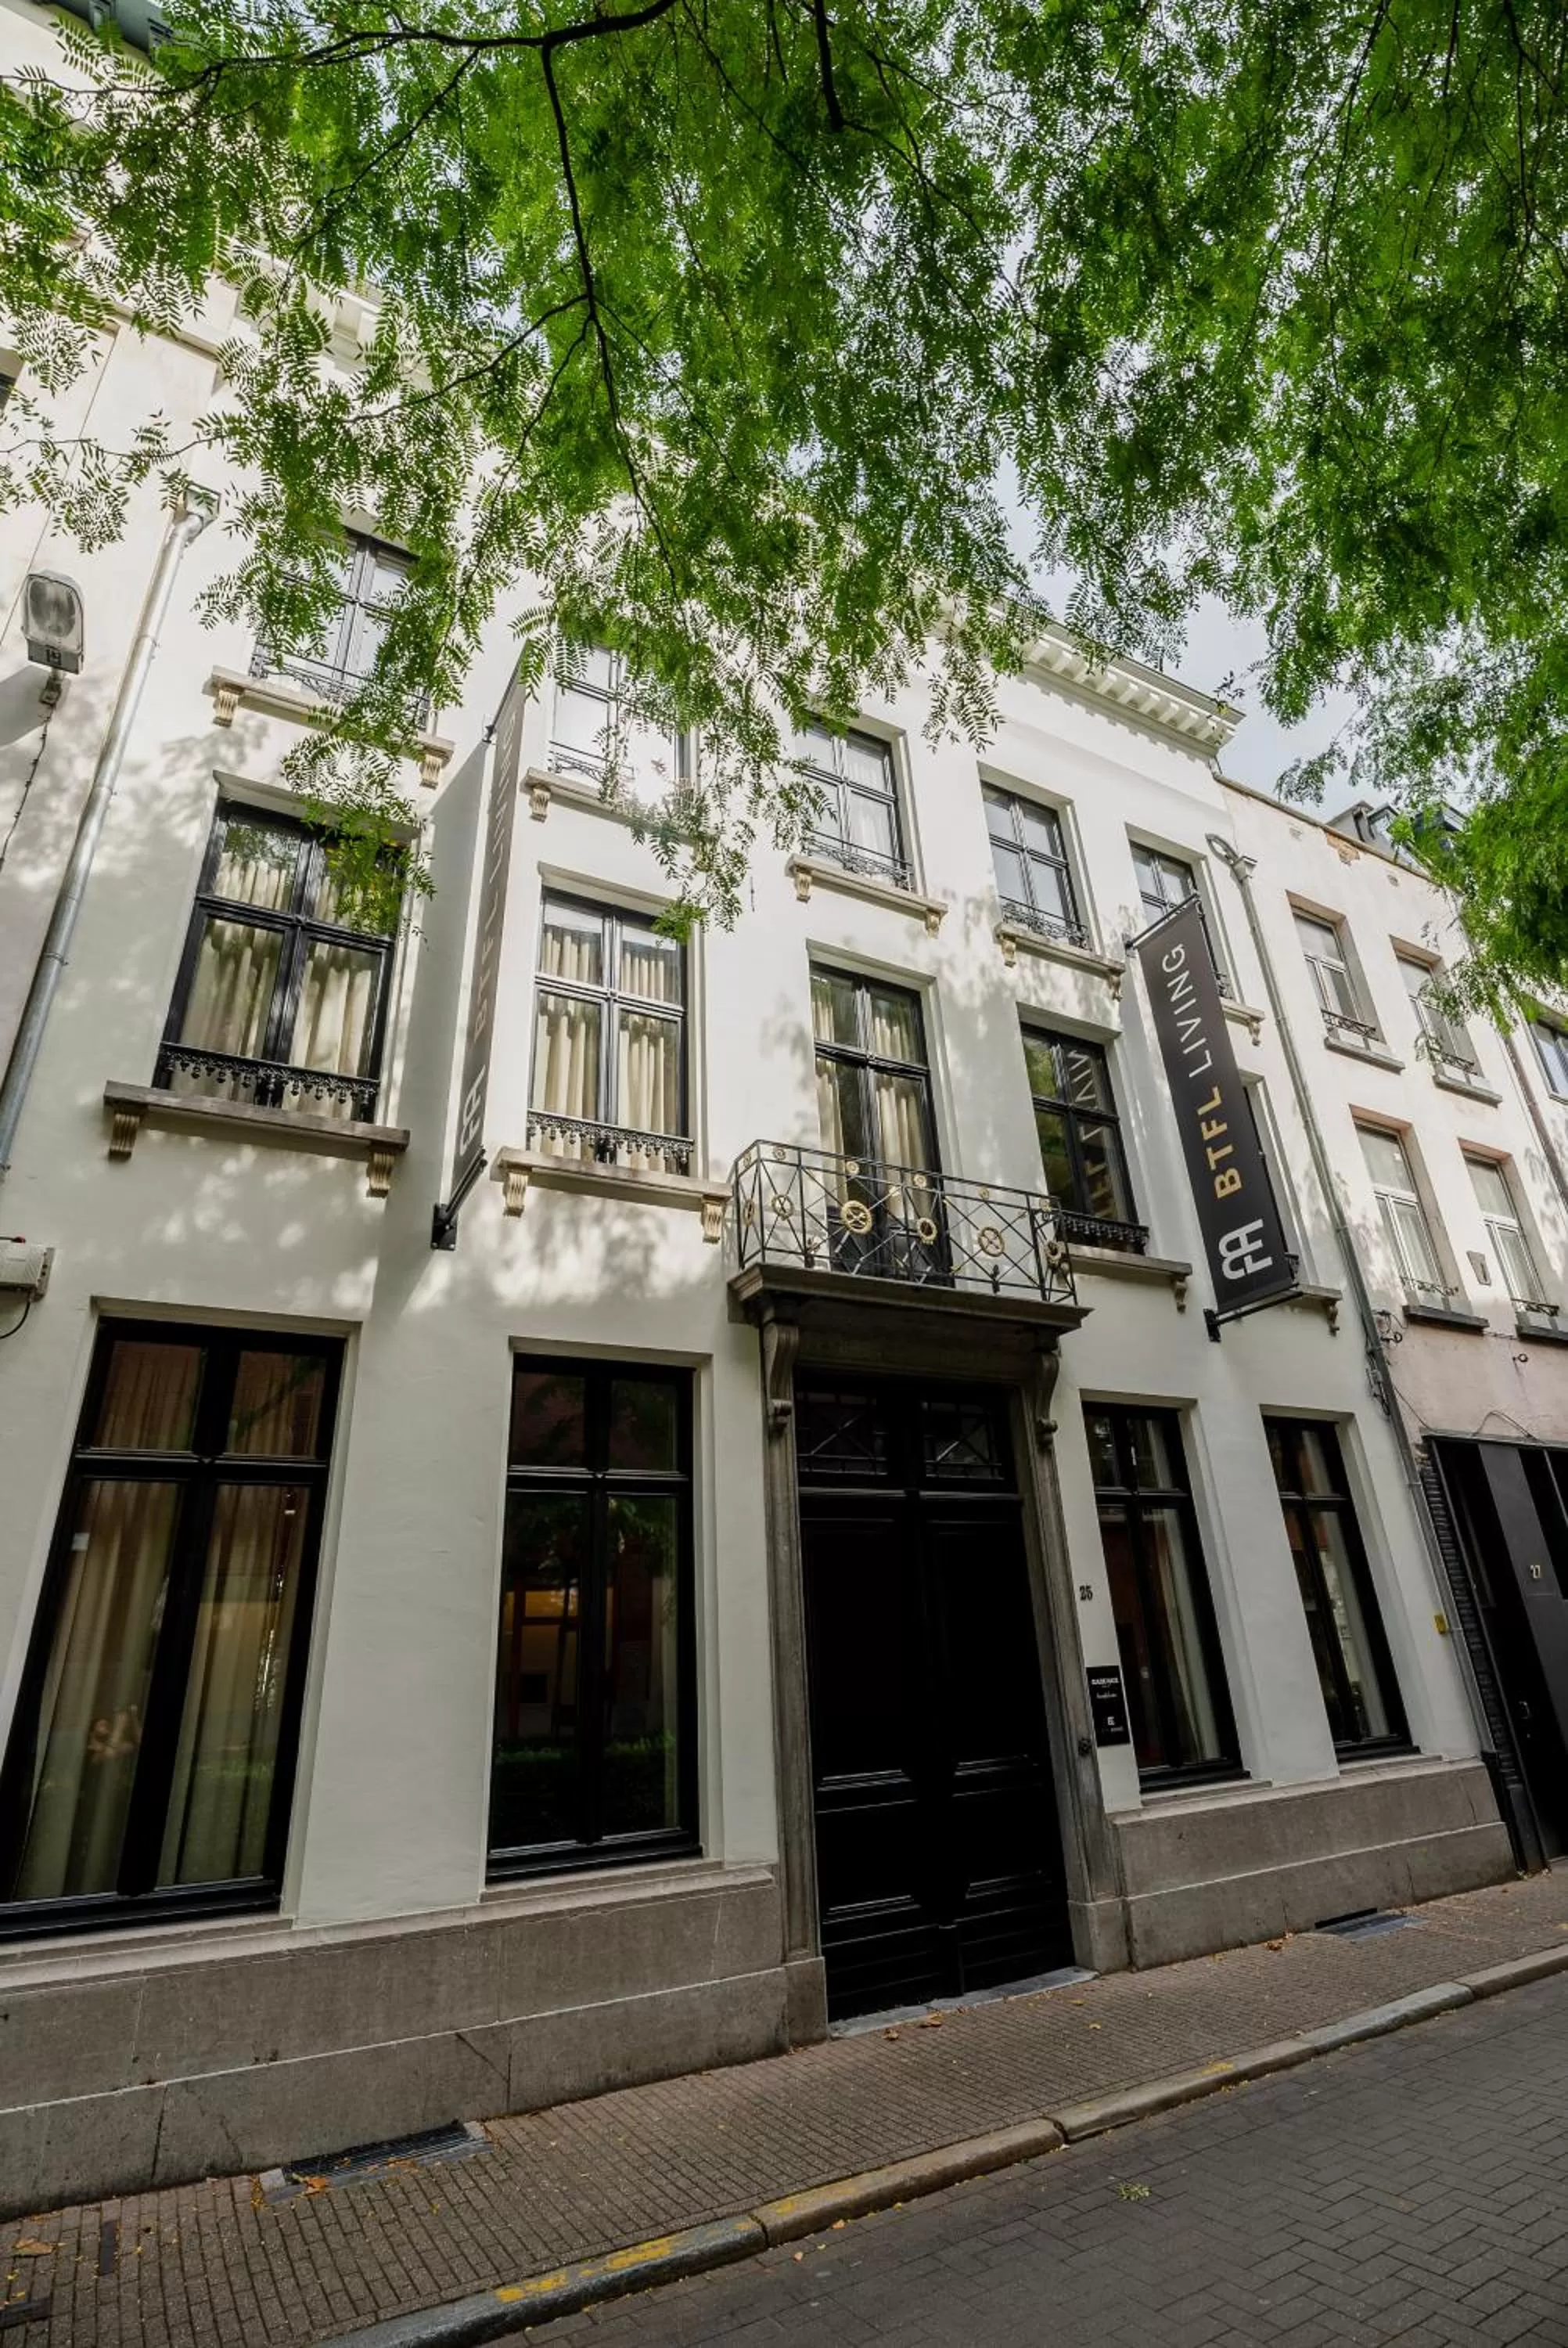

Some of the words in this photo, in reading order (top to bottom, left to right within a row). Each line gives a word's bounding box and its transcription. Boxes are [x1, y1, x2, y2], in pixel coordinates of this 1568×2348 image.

[475, 891, 498, 1042] BTFL
[488, 708, 516, 884] LIVING
[1161, 944, 1212, 1079] LIVING
[1196, 1086, 1243, 1200] BTFL
[1079, 1585, 1093, 1601] 25
